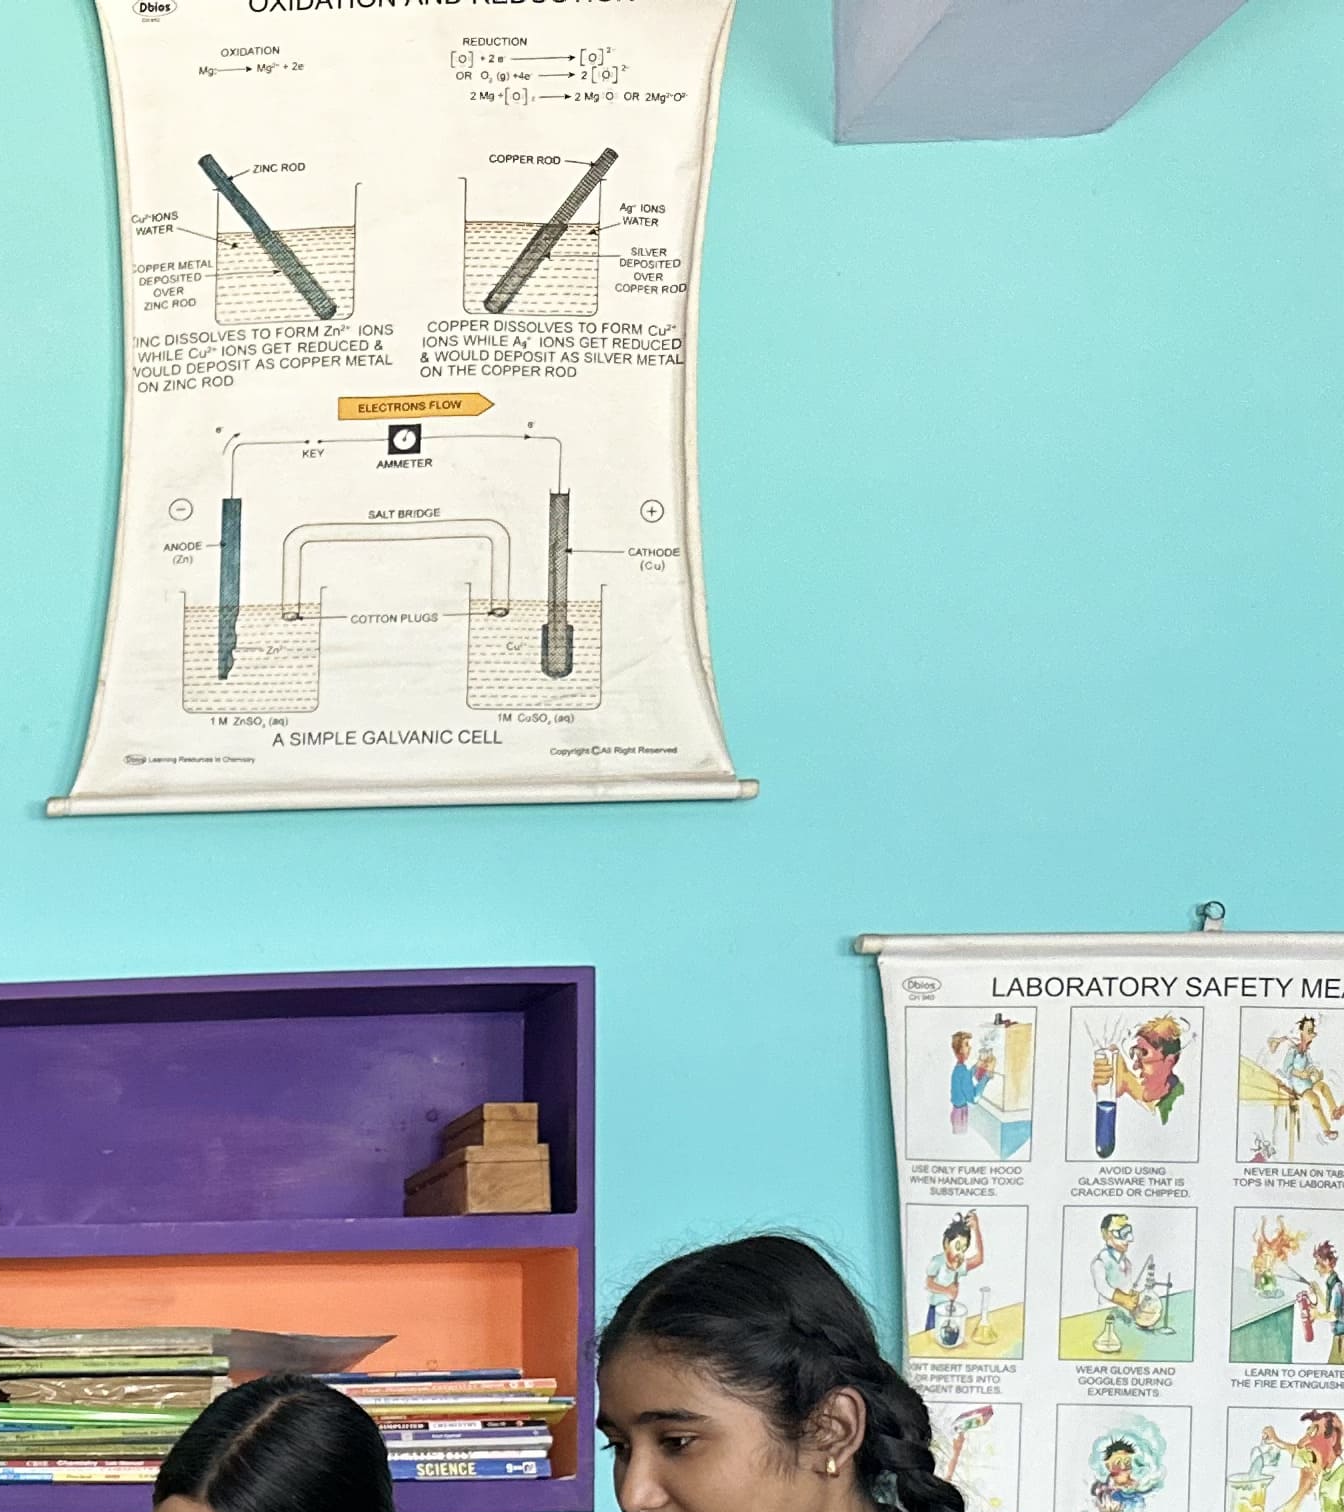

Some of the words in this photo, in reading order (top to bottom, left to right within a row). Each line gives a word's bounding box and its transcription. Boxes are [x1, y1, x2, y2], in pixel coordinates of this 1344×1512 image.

[463, 37, 527, 46] REDUCTION
[221, 46, 280, 57] OXIDATION
[489, 154, 534, 164] COPPER
[537, 156, 560, 164] ROD
[253, 164, 278, 173] ZINC
[281, 162, 306, 172] ROD
[427, 320, 489, 333] COPPER
[494, 321, 573, 334] DISSOLVES
[579, 322, 597, 334] TO
[602, 323, 642, 335] FORM
[135, 336, 159, 348] INC
[165, 330, 246, 346] DISSOLVES
[252, 328, 271, 340] TO
[276, 326, 319, 338] FORM
[359, 324, 394, 336] IONS
[422, 336, 458, 347] IONS
[464, 335, 508, 347] WHILE
[539, 337, 575, 348] IONS
[580, 338, 607, 349] GET
[612, 338, 682, 350] REDUCED
[138, 351, 183, 363] WHILE
[222, 345, 257, 357] IONS
[262, 343, 292, 355] GET
[298, 340, 369, 352] REDUCED
[374, 340, 383, 351] &
[421, 352, 429, 363] &
[435, 350, 489, 362] WOULD
[494, 350, 555, 363] DEPOSIT
[560, 352, 579, 363] AS
[584, 352, 632, 364] SILVER
[637, 353, 684, 365] METAL
[187, 360, 250, 374] DEPOSIT
[256, 359, 275, 370] AS
[280, 356, 340, 369] COPPER
[346, 354, 392, 366] METAL
[420, 366, 442, 378] ON
[448, 365, 476, 376] THE
[481, 365, 540, 376] COPPER
[545, 365, 577, 377] ROD
[137, 382, 158, 393] ON
[163, 378, 197, 392] ZINC
[202, 376, 234, 388] ROD
[358, 402, 426, 413] ELECTRONS
[429, 400, 462, 410] FLOW
[302, 449, 324, 458] KEY
[376, 459, 433, 469] AMMETER
[368, 510, 393, 519] SALT
[397, 508, 440, 519] BRIDGE
[163, 542, 202, 552] ANODE
[628, 548, 680, 557] CATHODE
[350, 614, 397, 624] COTTON
[400, 612, 438, 624] PLUGS
[272, 733, 284, 746] A
[290, 731, 356, 746] SIMPLE
[362, 730, 453, 745] GALVANIC
[458, 730, 502, 745] CELL
[991, 977, 1177, 998] LABORATORY
[1185, 977, 1293, 998] SAFETY
[931, 1166, 956, 1174] ONLY
[958, 1166, 986, 1175] FUME
[989, 1167, 1022, 1175] HOOD
[1099, 1167, 1132, 1175] AVOID
[1134, 1167, 1166, 1176] USING
[1243, 1168, 1279, 1176] NEVER
[1281, 1168, 1307, 1177] LEAN
[1309, 1169, 1323, 1177] ON
[910, 1176, 936, 1184] WHEN
[937, 1176, 989, 1185] HANDLING
[991, 1177, 1024, 1186] TOXIC
[1078, 1177, 1145, 1187] GLASSWARE
[1148, 1178, 1172, 1187] THAT
[1174, 1178, 1185, 1187] IS
[1233, 1178, 1262, 1187] TOPS
[1265, 1179, 1275, 1187] IN
[1277, 1179, 1297, 1188] THE
[1070, 1188, 1124, 1197] CRACKED
[1126, 1189, 1143, 1197] OR
[1076, 1365, 1108, 1375] WEAR
[1110, 1366, 1156, 1375] GLOVES
[1158, 1366, 1176, 1375] AND
[1244, 1368, 1279, 1378] LEARN
[1281, 1369, 1296, 1378] TO
[1078, 1376, 1128, 1386] GOGGLES
[1131, 1377, 1173, 1387] DURING
[416, 1462, 477, 1476] SCIENCE
